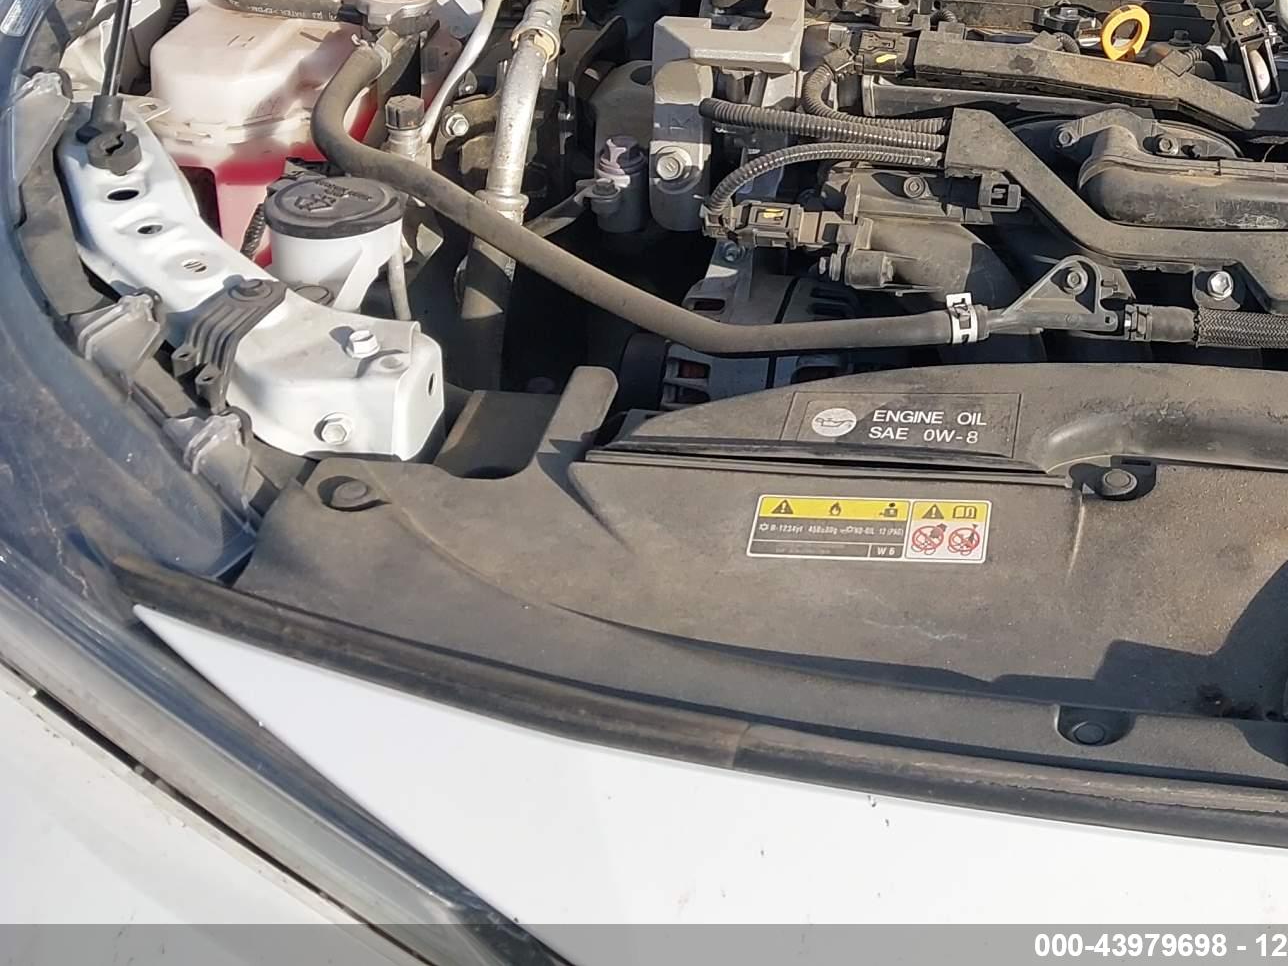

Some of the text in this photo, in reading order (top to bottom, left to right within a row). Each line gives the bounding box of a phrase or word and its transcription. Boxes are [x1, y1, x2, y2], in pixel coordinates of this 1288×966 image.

[872, 409, 987, 426] ENGINE OIL
[868, 426, 979, 444] SAE 0W-8
